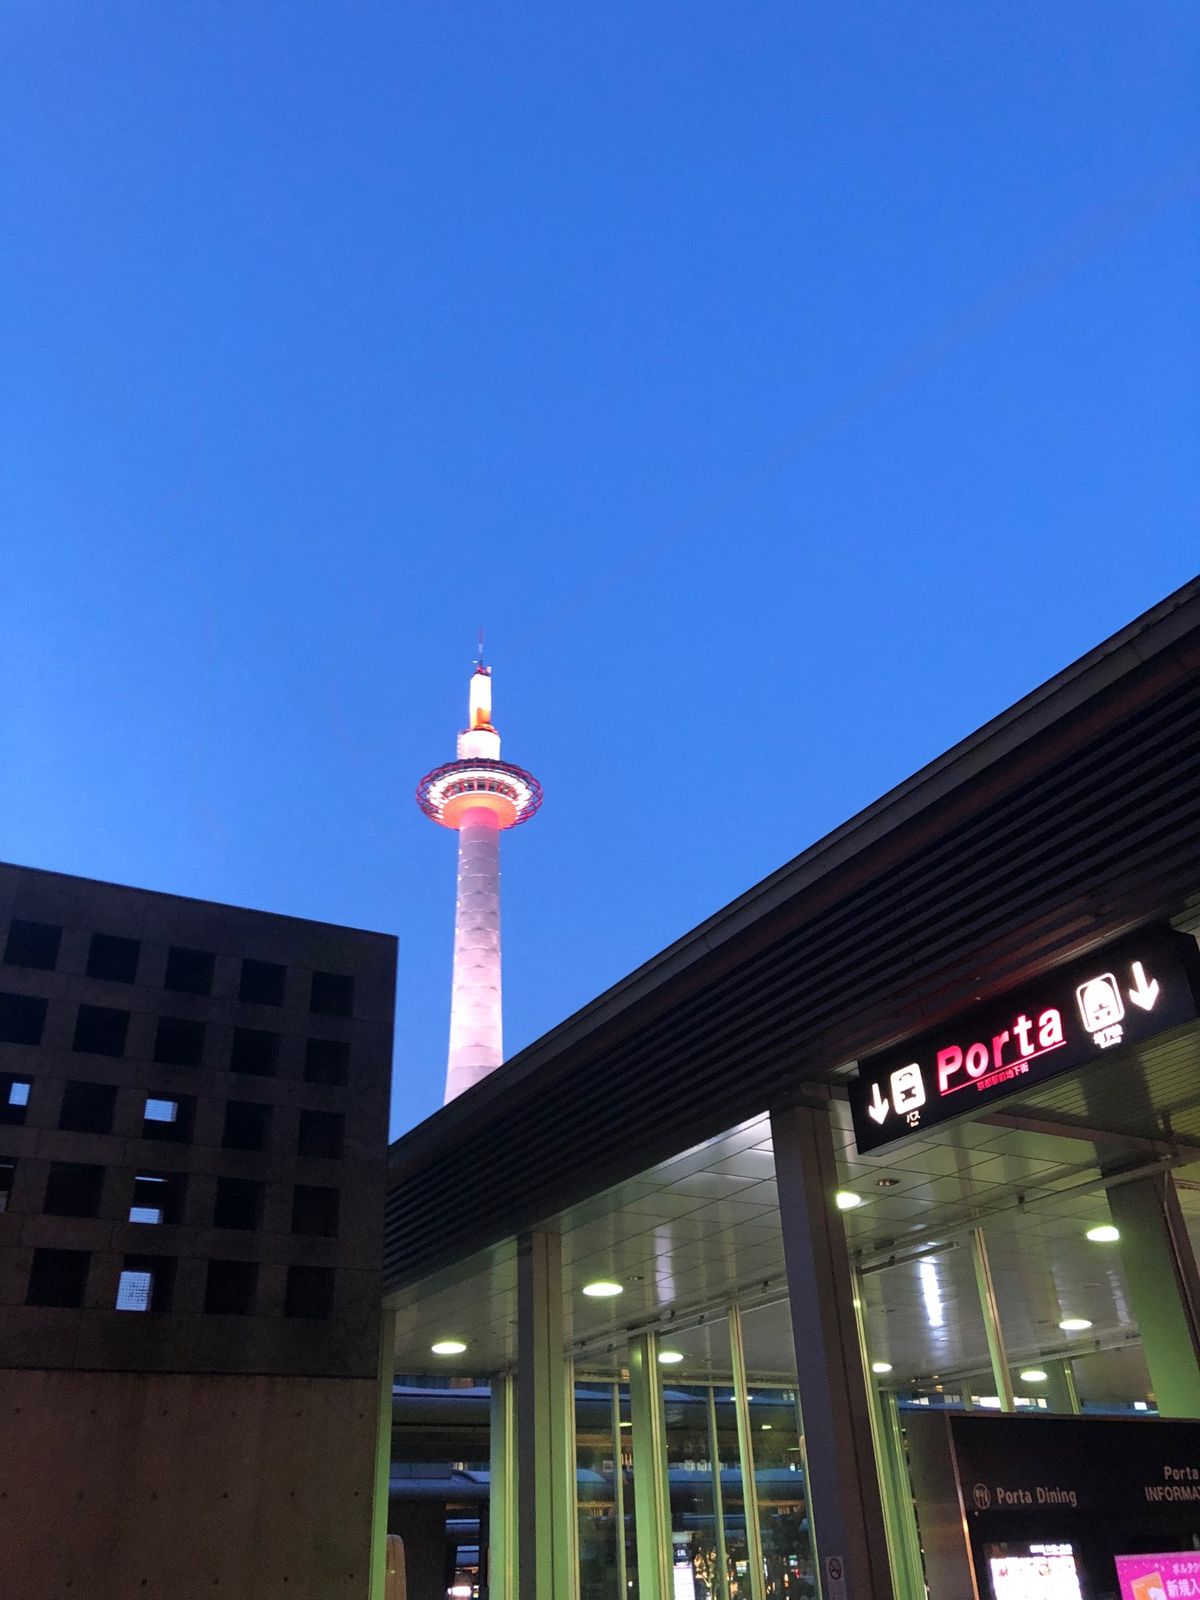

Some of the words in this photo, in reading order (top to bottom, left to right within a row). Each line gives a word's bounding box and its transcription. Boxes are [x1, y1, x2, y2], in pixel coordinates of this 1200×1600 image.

[937, 1009, 1063, 1092] Porta
[1163, 1465, 1199, 1480] Porta
[996, 1487, 1032, 1504] Porta
[1036, 1486, 1077, 1507] Dining
